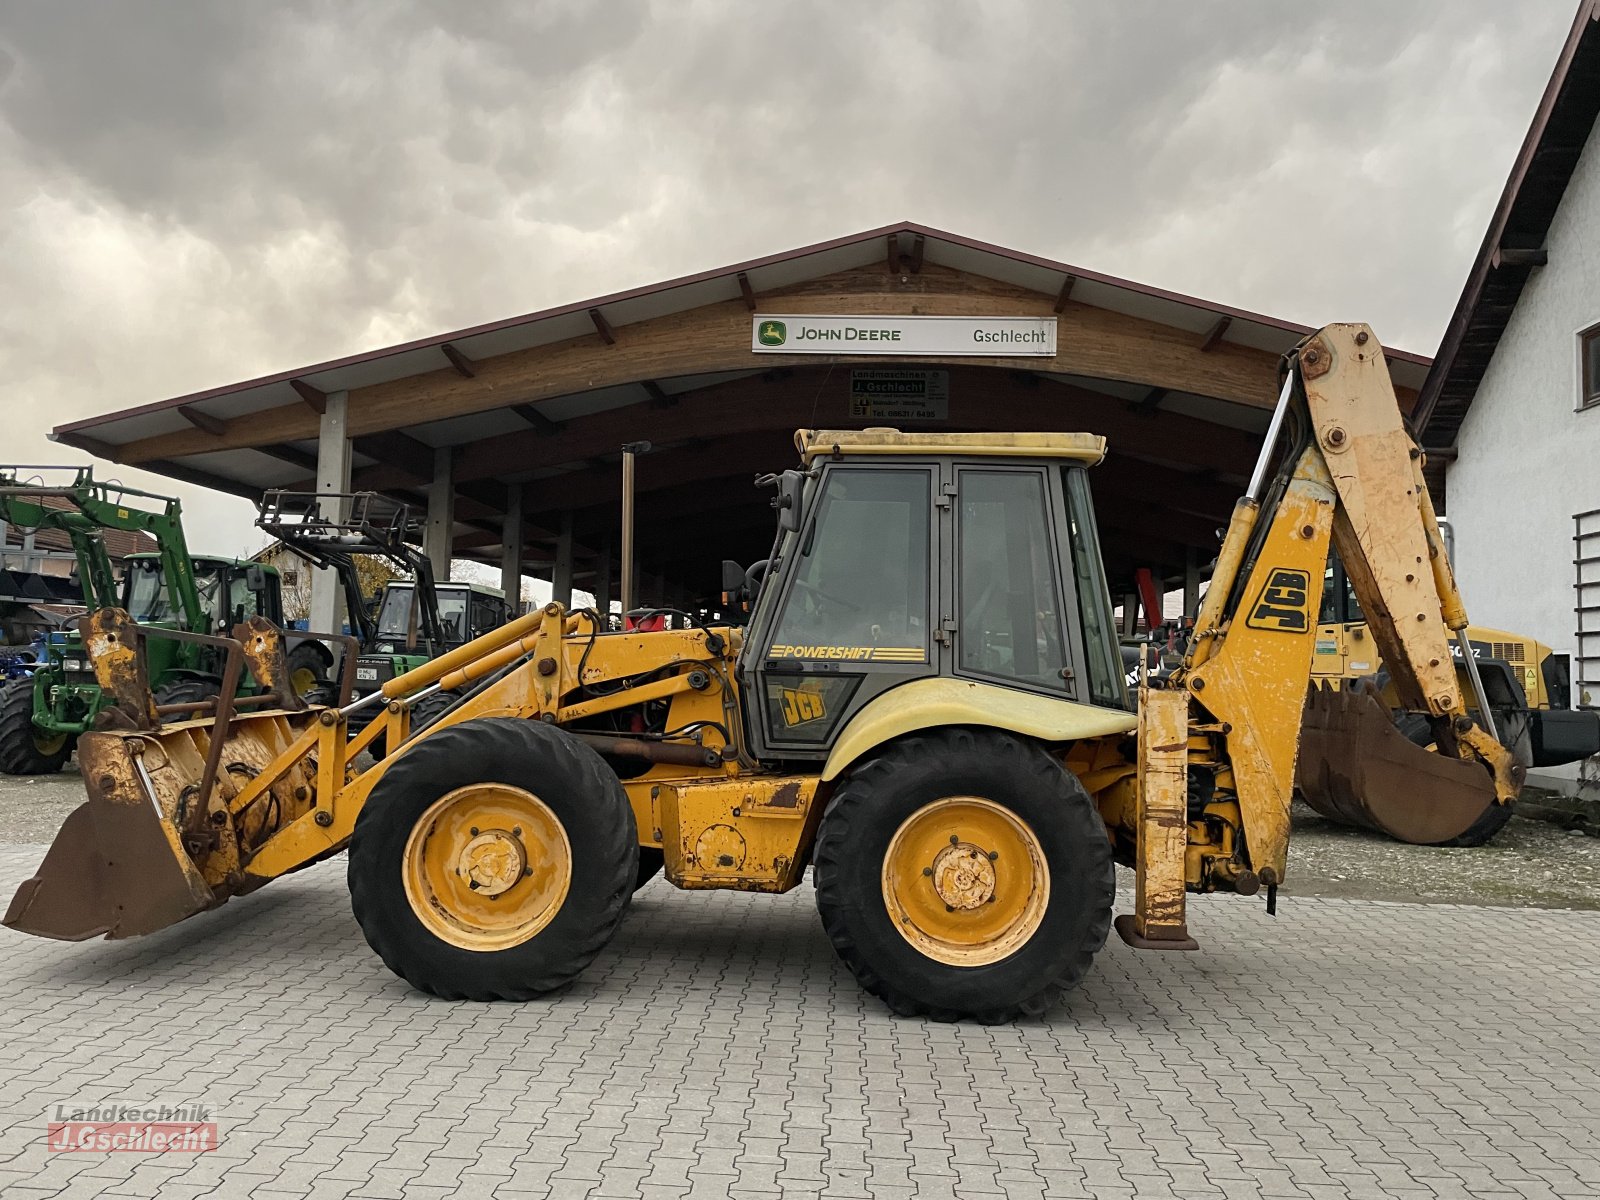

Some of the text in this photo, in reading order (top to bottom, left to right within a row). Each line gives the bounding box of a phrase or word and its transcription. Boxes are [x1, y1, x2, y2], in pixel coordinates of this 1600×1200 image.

[796, 327, 1047, 343] JOHN DEERE Gschlecht
[866, 381, 923, 391] Gschlecht
[1256, 571, 1308, 629] JCB
[783, 646, 874, 659] POWERSHIFT
[784, 690, 824, 726] JCB
